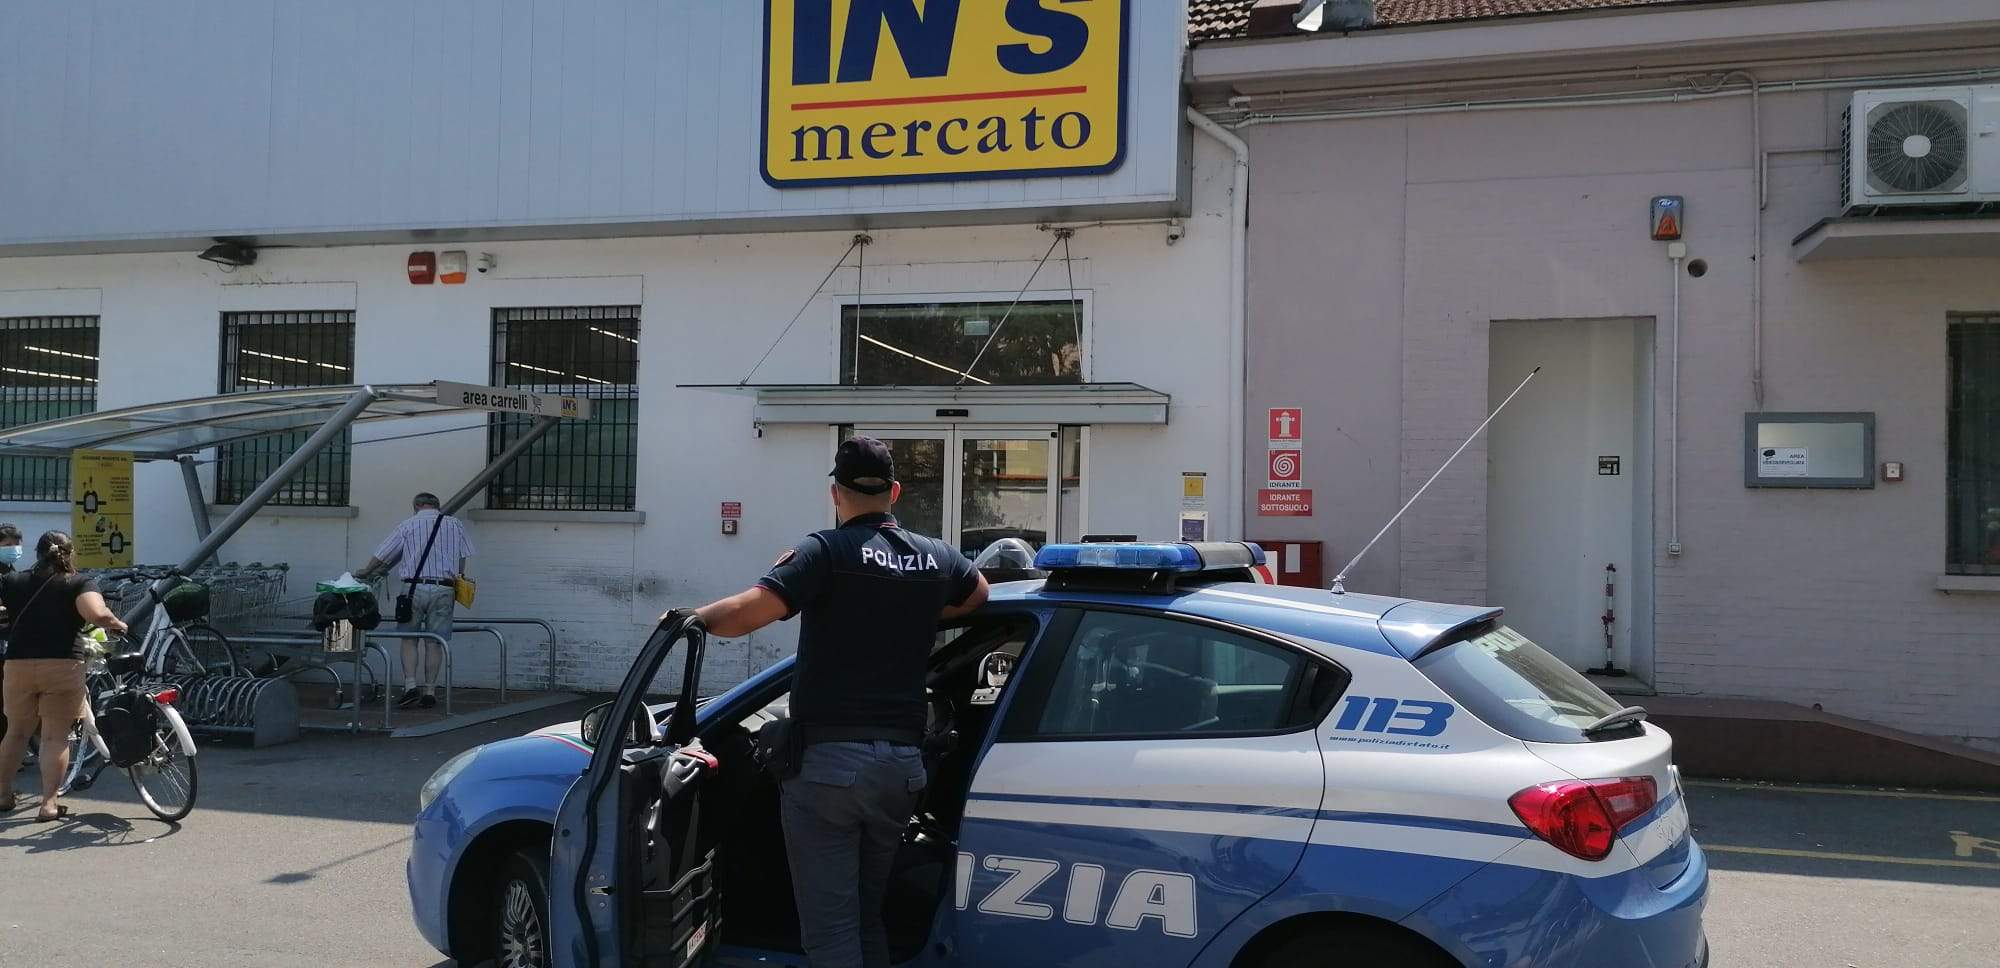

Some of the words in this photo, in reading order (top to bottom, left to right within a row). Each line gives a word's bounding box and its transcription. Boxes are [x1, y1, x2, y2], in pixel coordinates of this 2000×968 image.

[789, 106, 1091, 162] mercato
[463, 391, 488, 405] area
[490, 393, 528, 411] carrelli
[1261, 503, 1309, 512] SOTTOSUOLO
[861, 547, 939, 571] POLIZIA
[1334, 695, 1455, 737] 113
